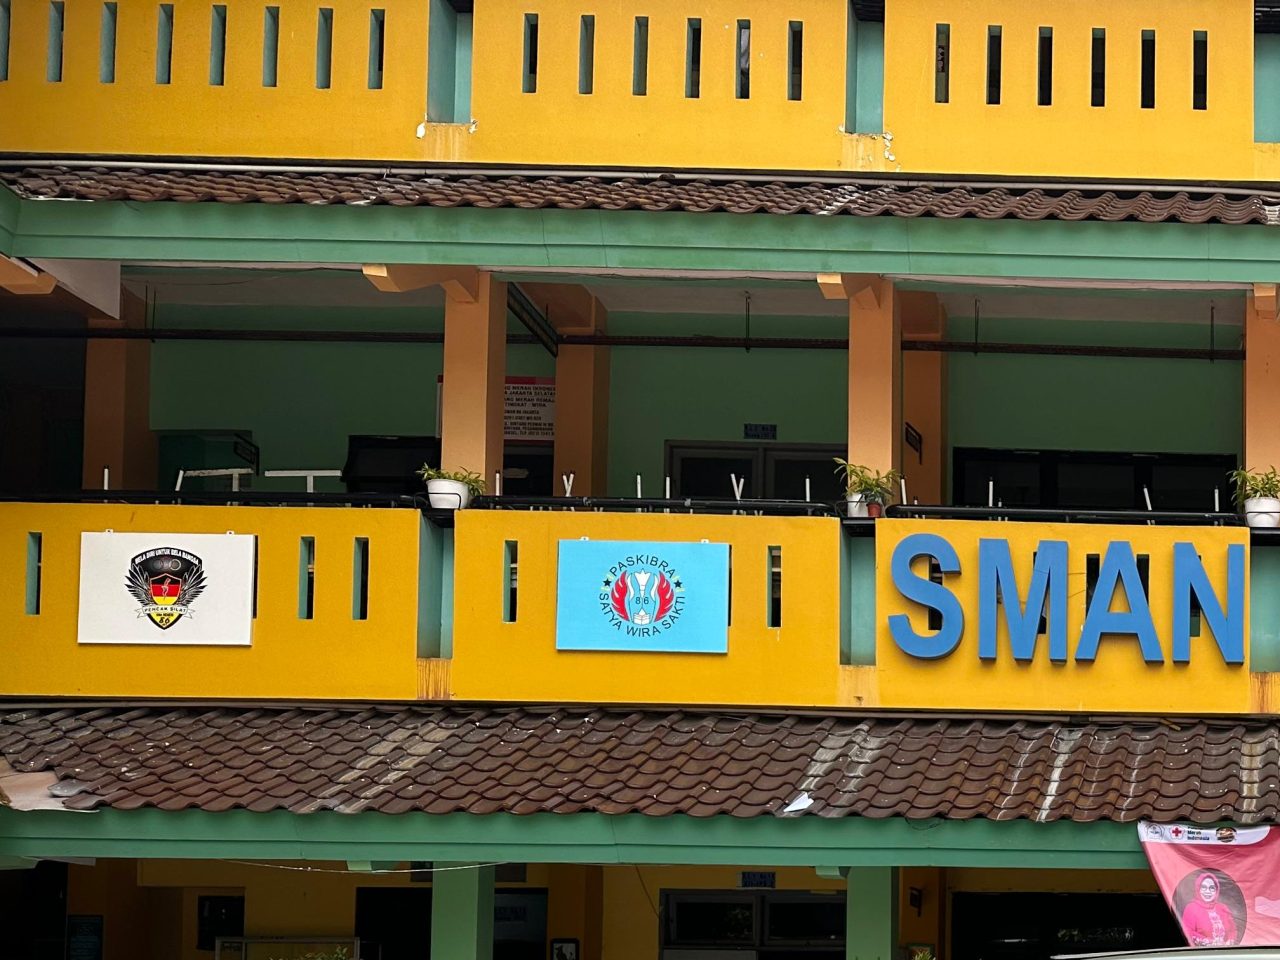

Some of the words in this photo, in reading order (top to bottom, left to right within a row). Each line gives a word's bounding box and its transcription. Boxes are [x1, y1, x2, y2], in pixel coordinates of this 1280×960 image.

[609, 554, 676, 579] PASKIBRA
[599, 592, 622, 631] SATYA
[626, 625, 661, 637] WIRA
[661, 595, 686, 630] SAKTI
[888, 533, 1246, 666] SMAN
